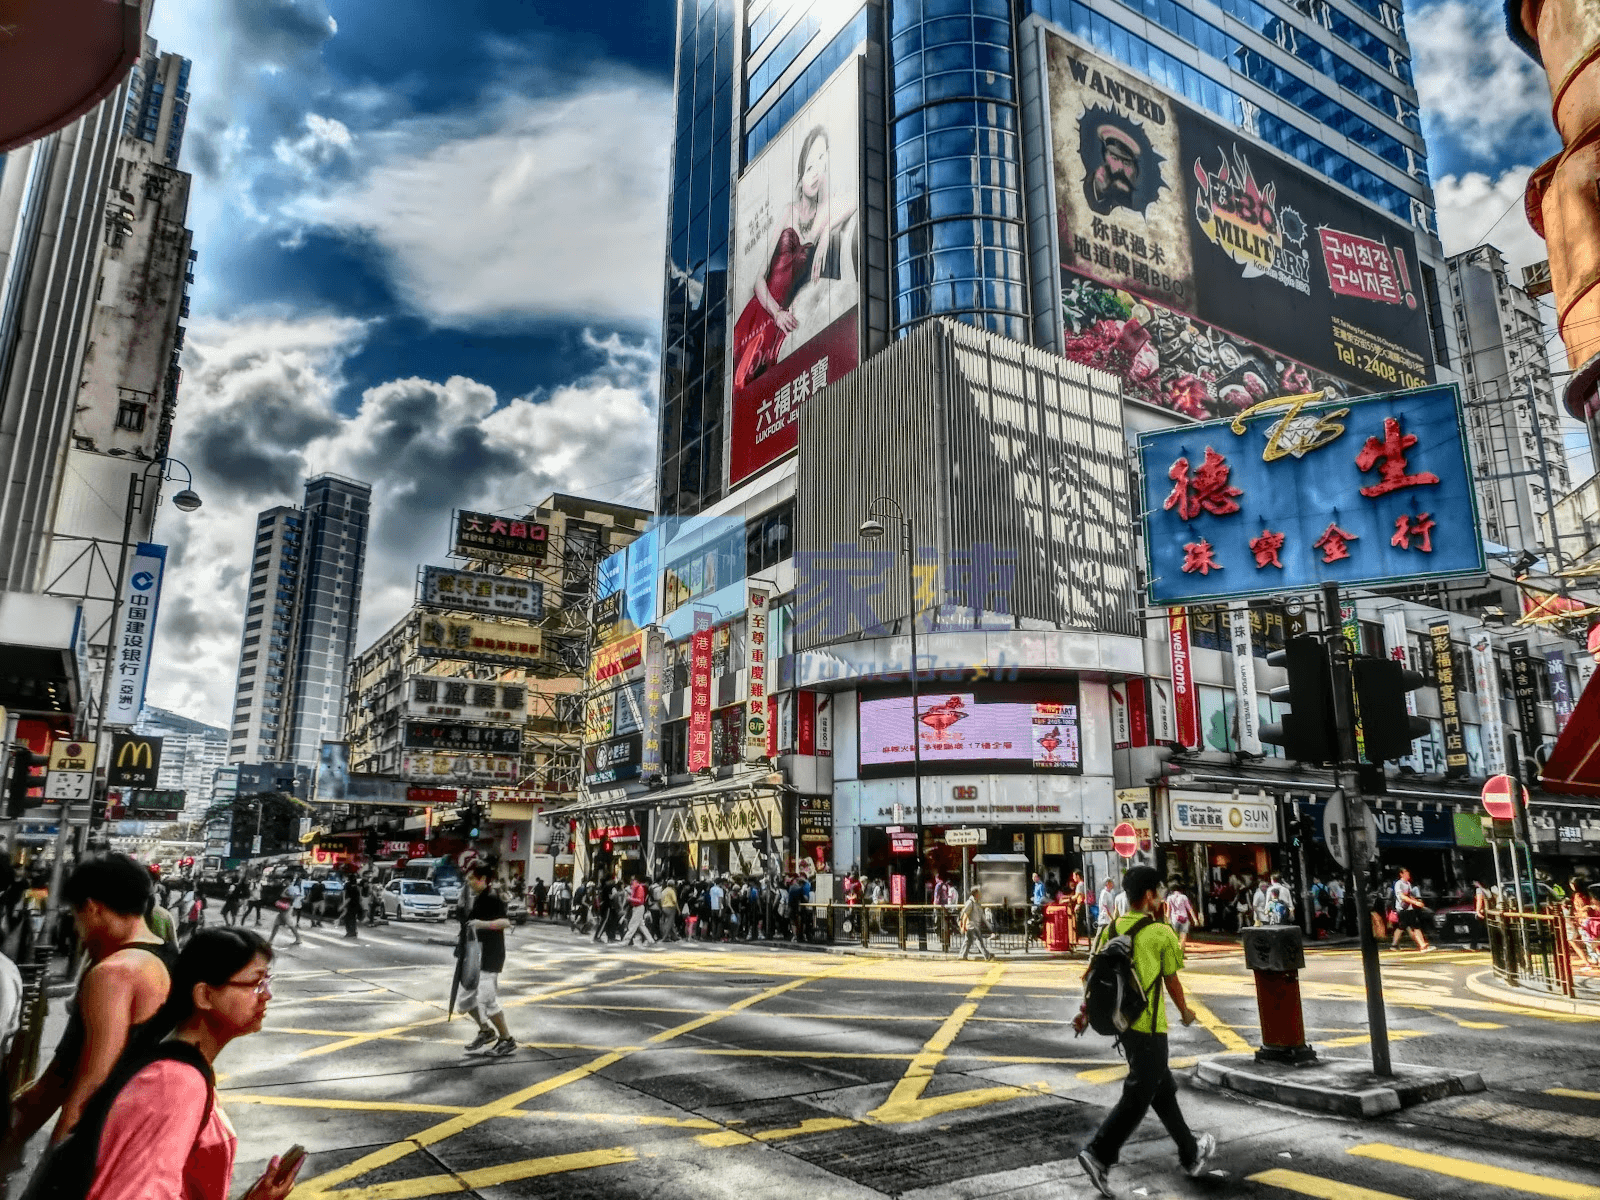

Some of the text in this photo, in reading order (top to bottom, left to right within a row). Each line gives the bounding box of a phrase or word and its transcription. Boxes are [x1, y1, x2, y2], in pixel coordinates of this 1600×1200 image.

[1066, 55, 1166, 126] WANTED
[1215, 216, 1310, 283] MILITARY
[756, 354, 829, 432] 六福珠寶
[1363, 354, 1397, 383] 2408
[755, 416, 785, 445] LUKFOOK
[1181, 511, 1437, 576] 珠寶金行
[750, 613, 766, 716] 至尊重慶雞煲
[1173, 631, 1188, 695] wellcome
[1432, 635, 1463, 750] 彩福婚宴專門店
[749, 719, 765, 731] 8/F
[1240, 664, 1253, 738] LUKFOOK JEWELLERY
[74, 788, 83, 798] 7
[76, 774, 84, 783] 7
[1244, 809, 1269, 822] SUN
